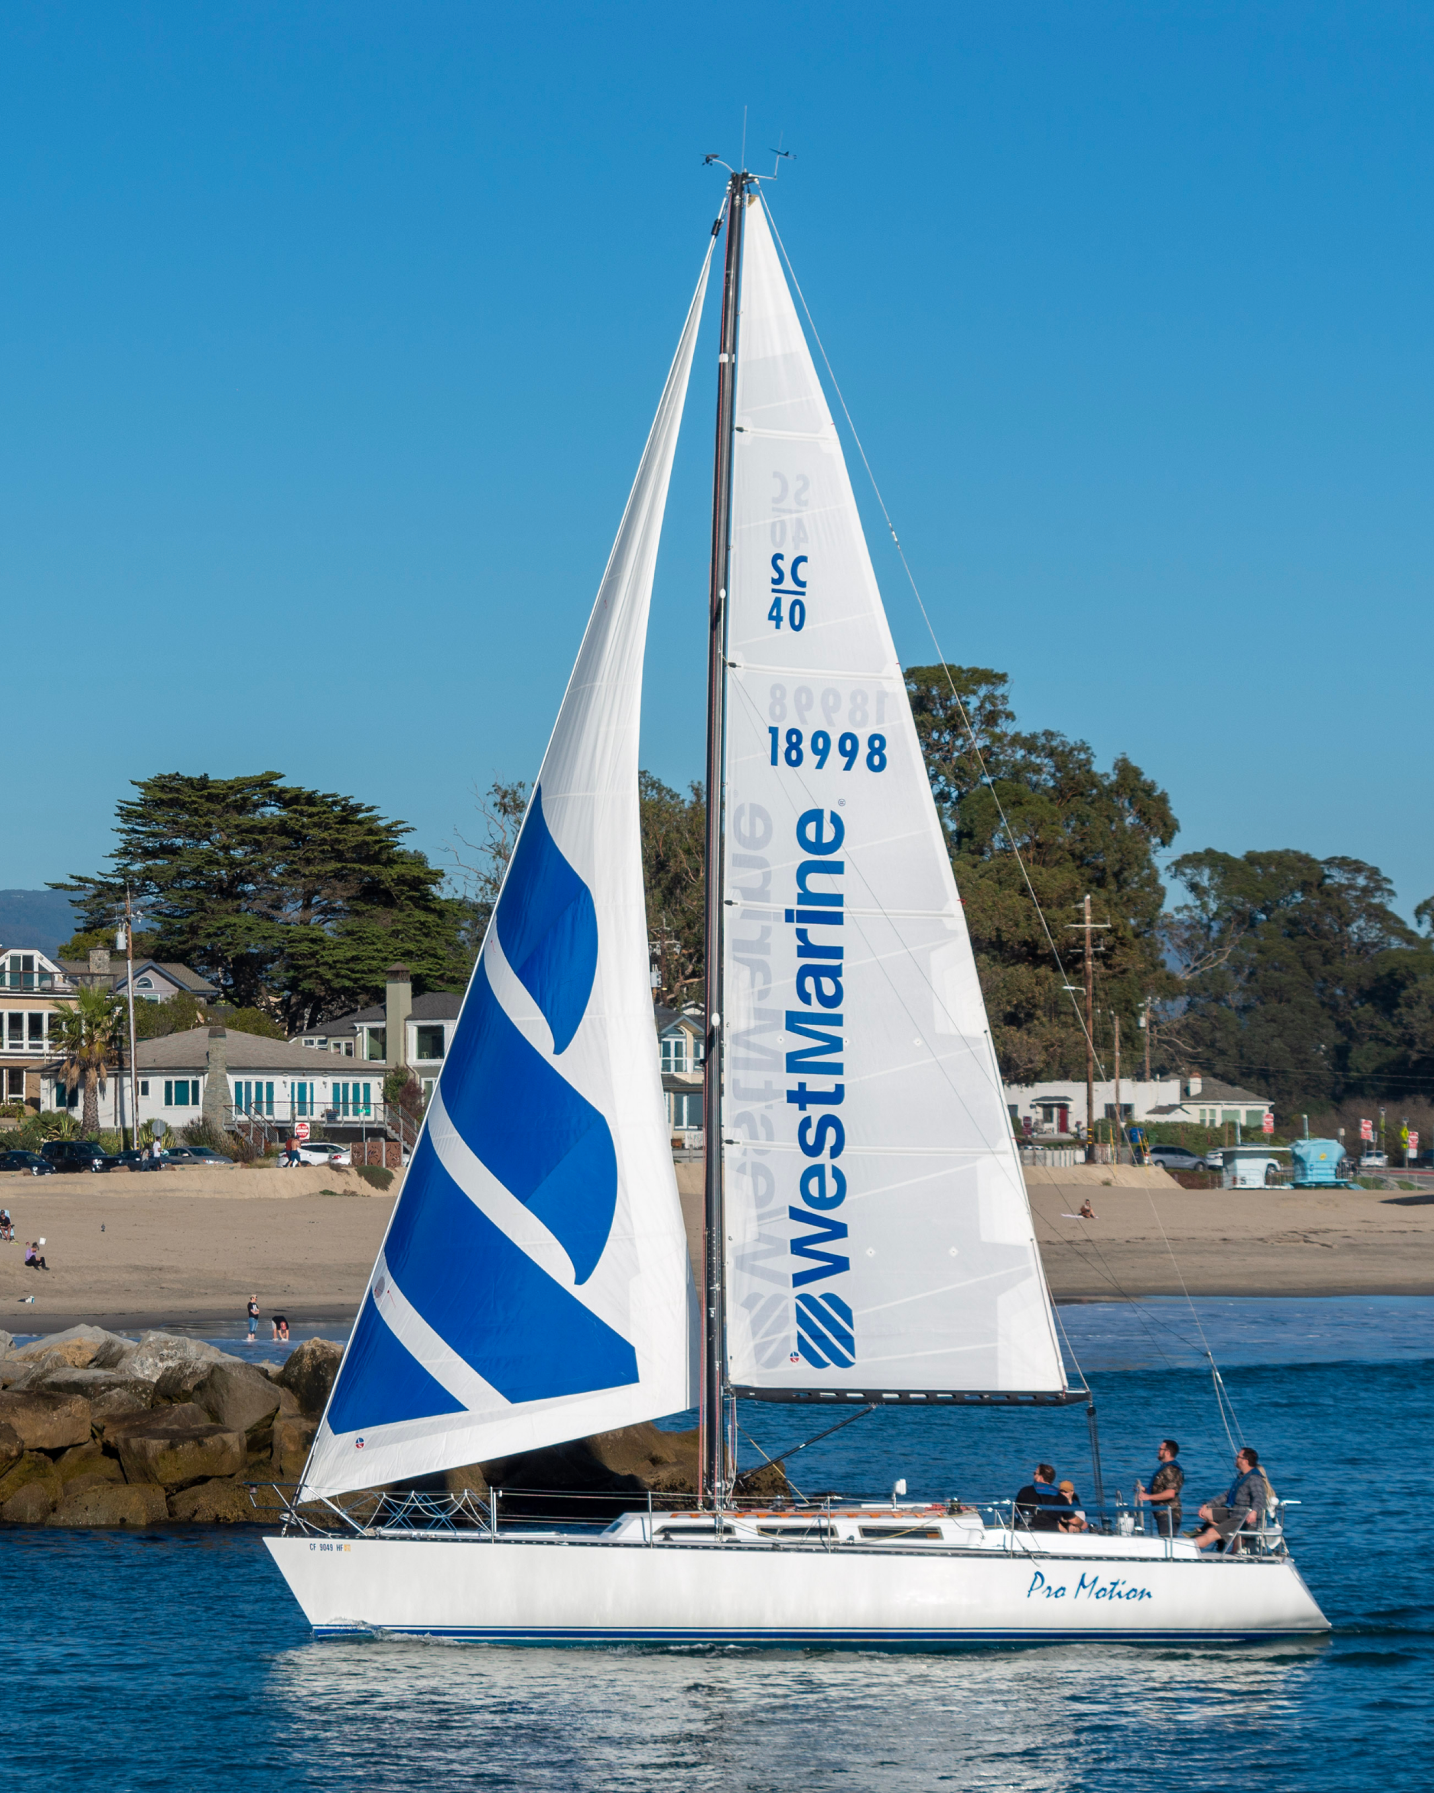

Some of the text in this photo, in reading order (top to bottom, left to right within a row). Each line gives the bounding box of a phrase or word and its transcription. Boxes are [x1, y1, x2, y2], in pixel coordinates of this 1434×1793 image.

[771, 553, 808, 588] SC
[768, 597, 806, 632] 40
[768, 726, 887, 773] 18998
[309, 1543, 316, 1551] CF
[1027, 1570, 1153, 1601] Pro Motion
